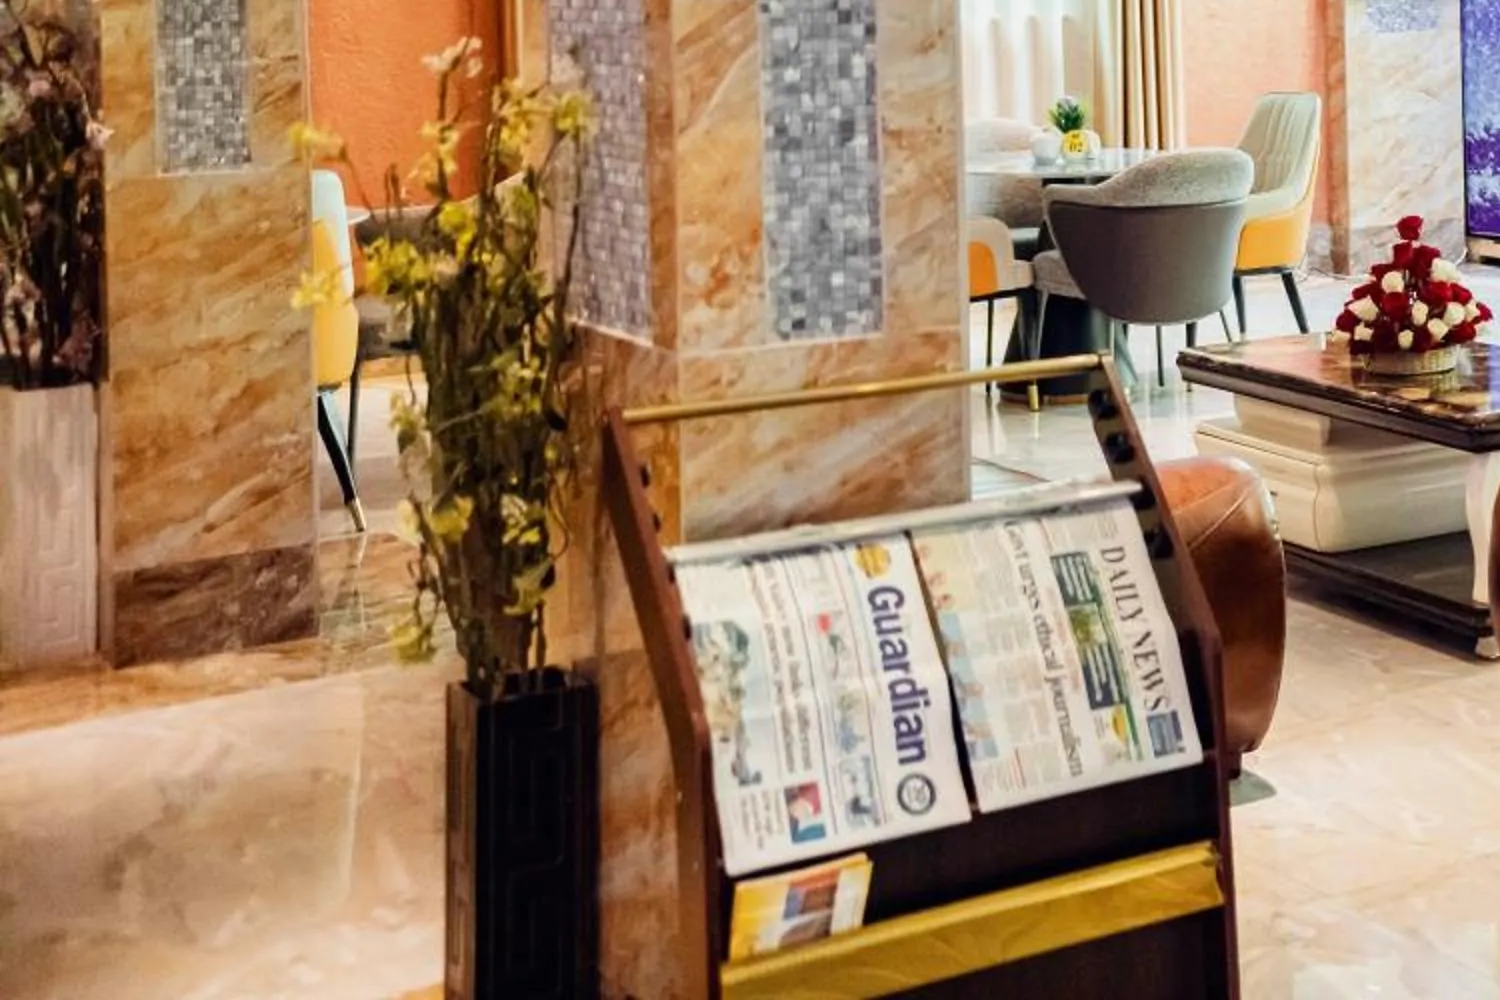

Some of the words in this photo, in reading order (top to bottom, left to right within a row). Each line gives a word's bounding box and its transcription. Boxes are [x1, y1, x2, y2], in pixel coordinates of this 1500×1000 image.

[866, 584, 931, 766] Guardian
[1100, 546, 1144, 622] DAILY
[1128, 630, 1172, 712] NEWS
[1043, 673, 1084, 777] journalism
